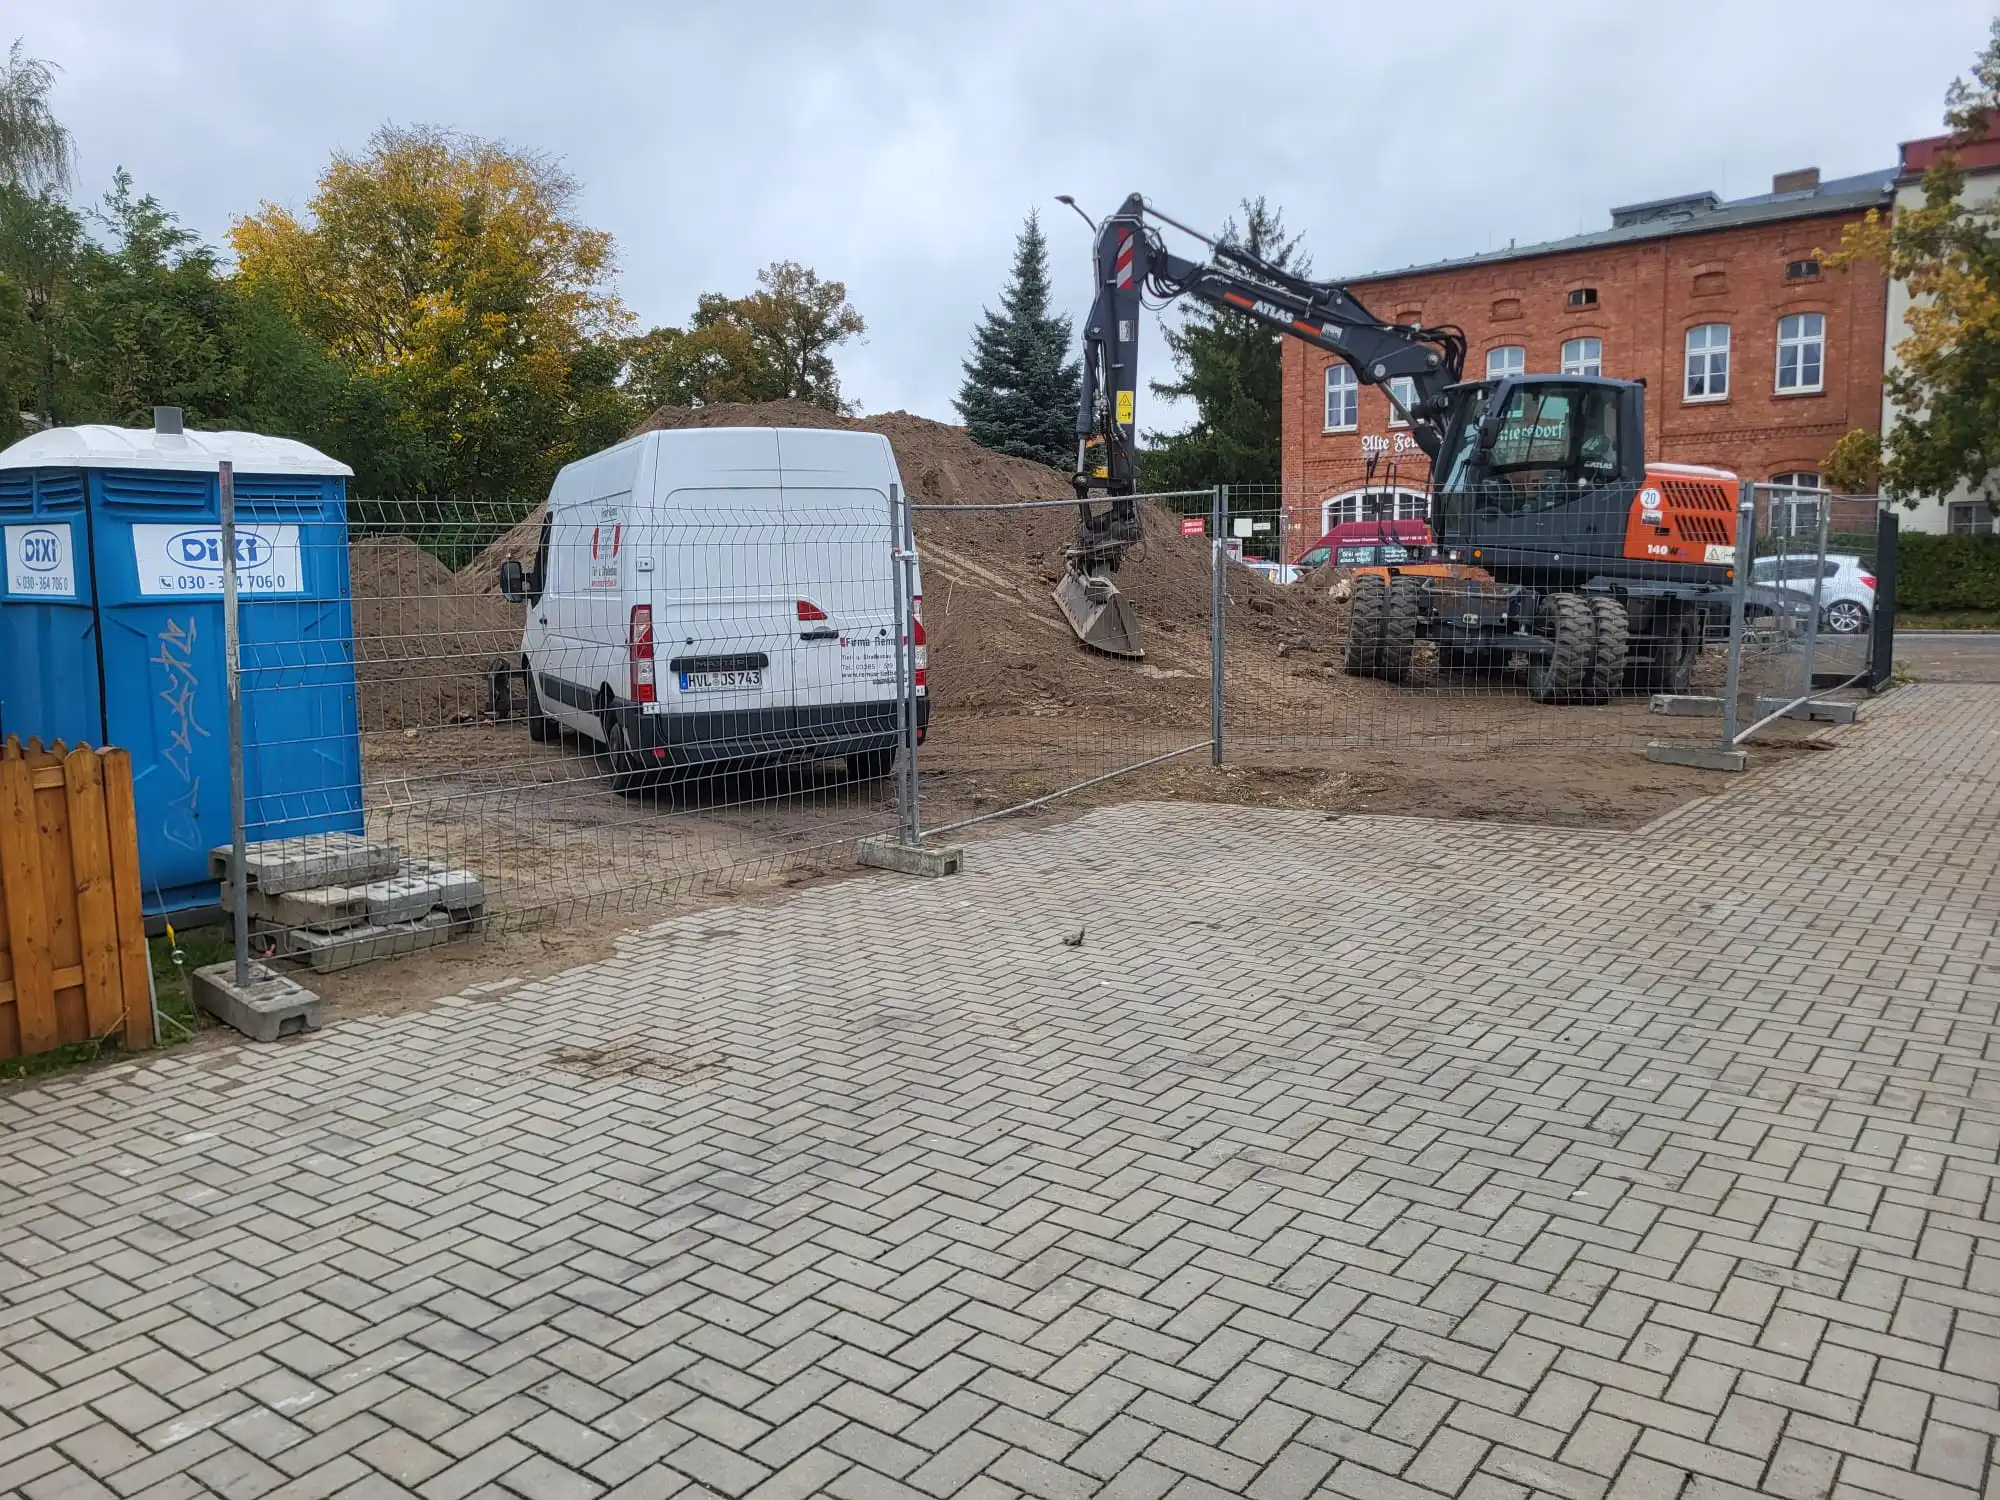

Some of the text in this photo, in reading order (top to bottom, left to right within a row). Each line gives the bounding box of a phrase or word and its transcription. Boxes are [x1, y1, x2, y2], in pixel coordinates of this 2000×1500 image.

[1252, 299, 1294, 324] ATLAS
[1361, 434, 1389, 450] Alte
[1644, 491, 1656, 505] 20
[23, 576, 34, 590] 030
[178, 575, 205, 589] 030
[218, 575, 243, 588] 34
[248, 575, 273, 588] 706
[278, 575, 285, 588] 0
[846, 637, 870, 647] Firma
[688, 674, 711, 688] HVL
[738, 671, 760, 683] 743
